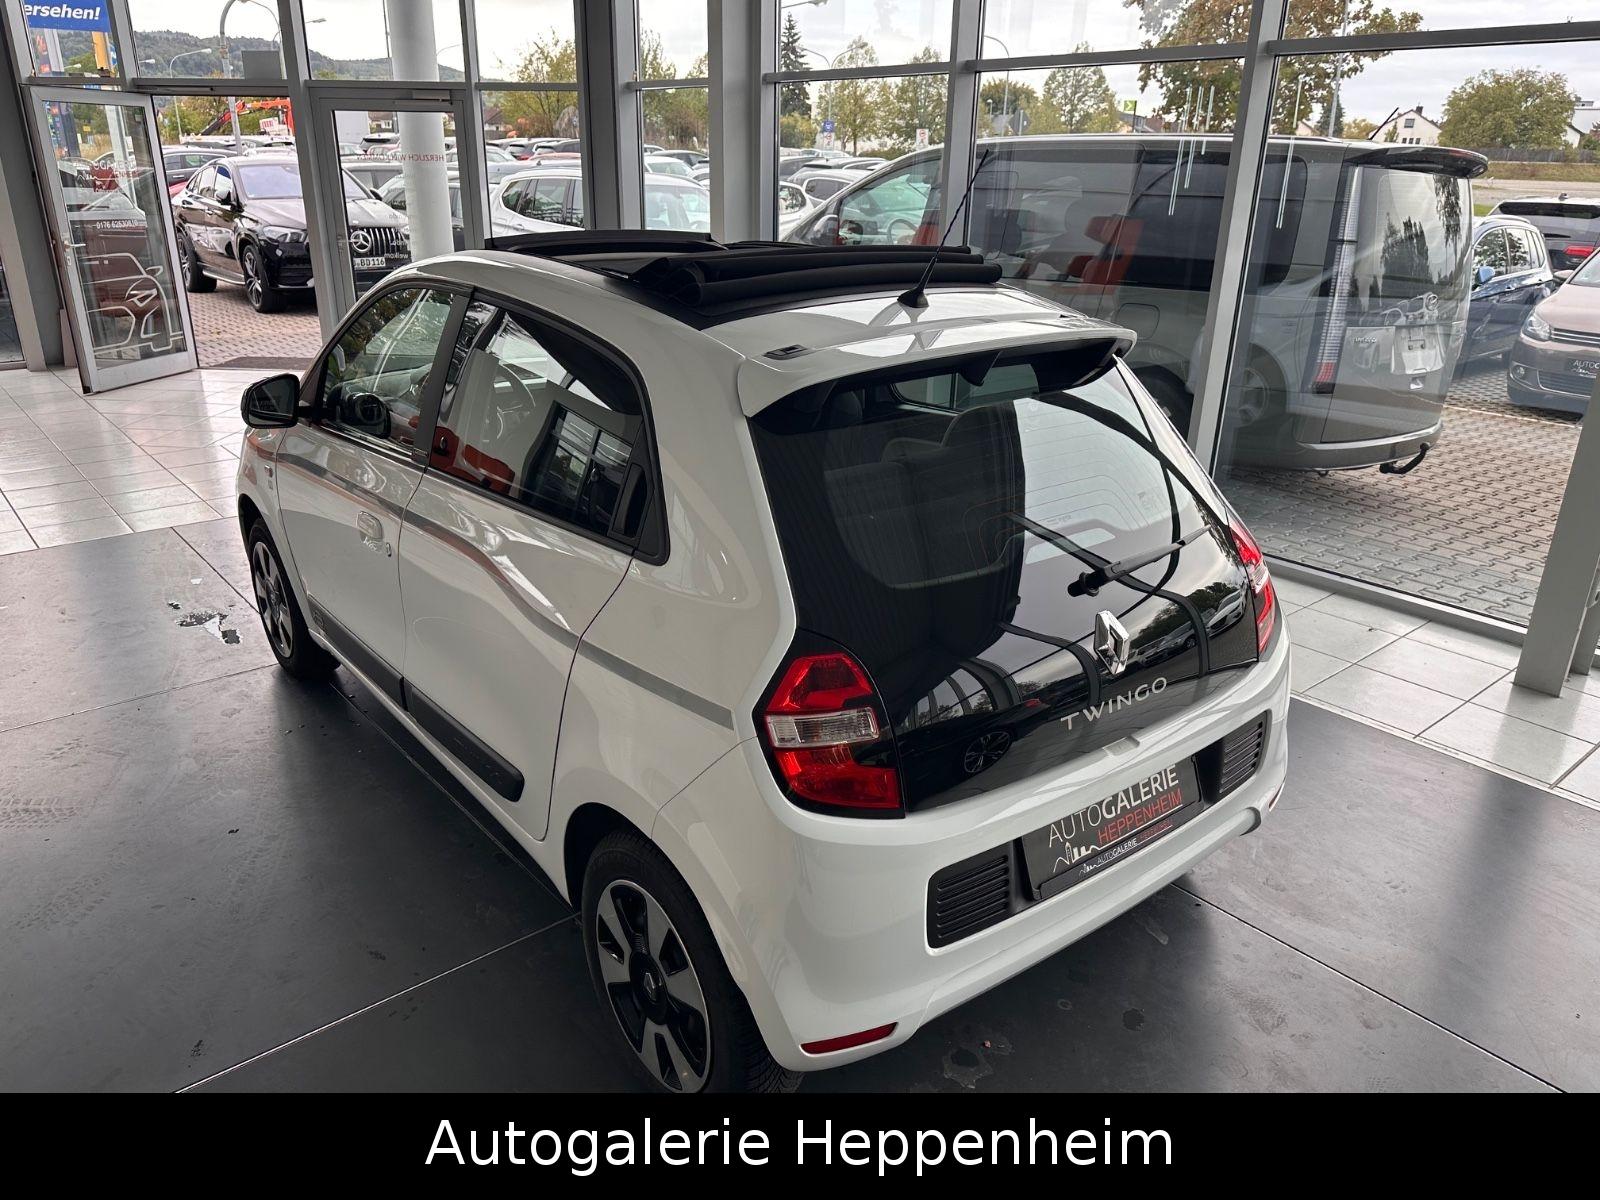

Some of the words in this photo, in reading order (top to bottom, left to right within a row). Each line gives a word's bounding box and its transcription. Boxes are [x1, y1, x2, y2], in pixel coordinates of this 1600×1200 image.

[24, 4, 101, 20] ersehen!
[96, 221, 111, 230] 0176
[1060, 677, 1167, 730] TWINGO
[1049, 764, 1179, 848] AUTOGALERIE
[1097, 787, 1182, 846] HEPPENHEIM
[1096, 837, 1138, 864] AUTOGALERIE
